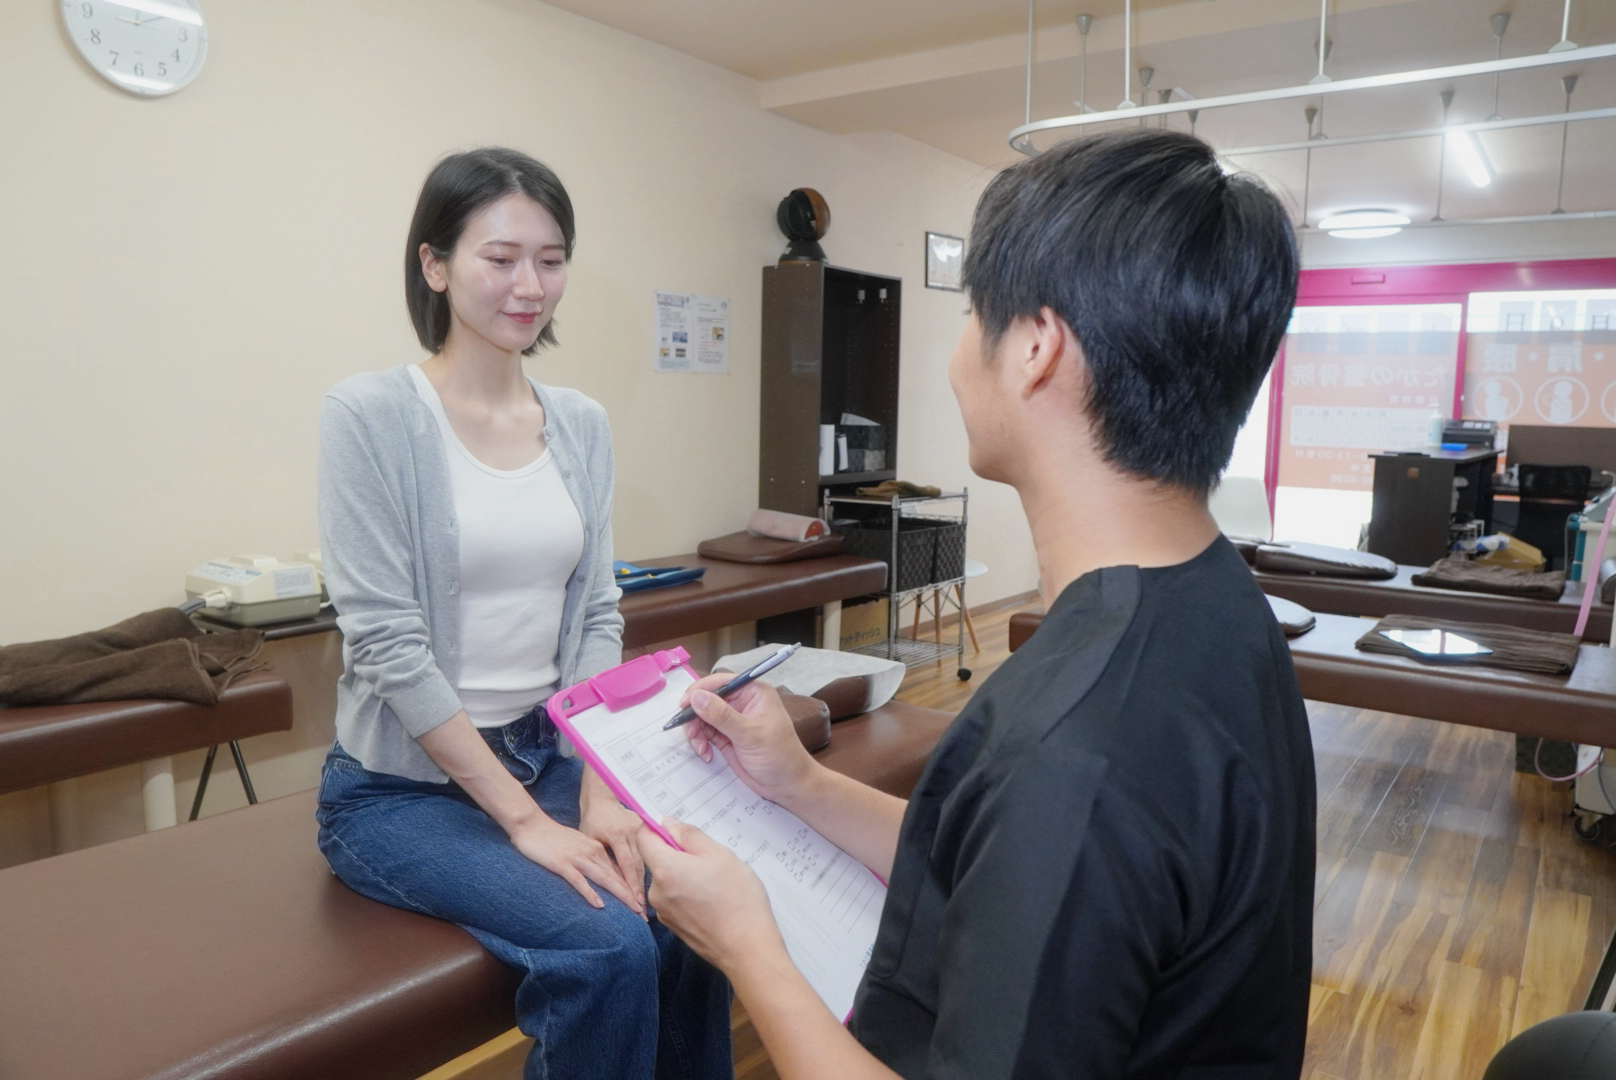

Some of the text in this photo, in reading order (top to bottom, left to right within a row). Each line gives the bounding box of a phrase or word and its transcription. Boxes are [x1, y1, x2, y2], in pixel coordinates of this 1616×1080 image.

[81, 2, 94, 19] 9
[90, 28, 102, 45] 8
[177, 27, 189, 43] 3
[108, 50, 120, 66] 7
[171, 48, 182, 63] 4
[133, 61, 145, 77] 6
[157, 61, 168, 77] 5
